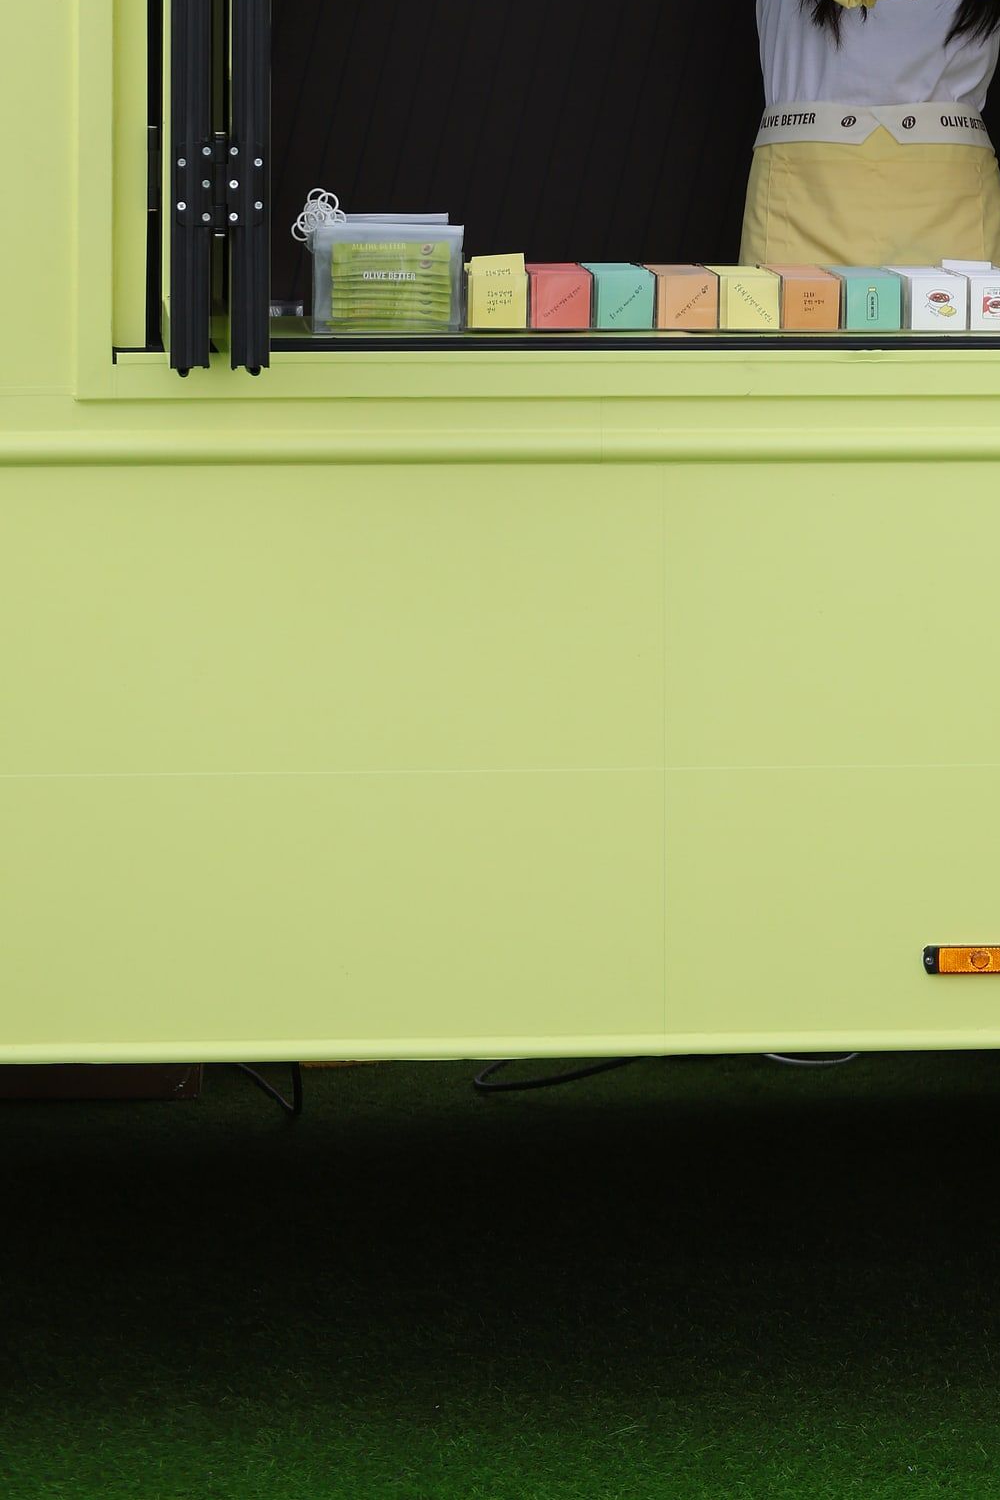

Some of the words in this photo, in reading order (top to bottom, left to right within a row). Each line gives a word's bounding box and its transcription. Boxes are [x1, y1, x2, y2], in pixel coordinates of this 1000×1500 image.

[781, 112, 816, 126] BETTER
[940, 115, 969, 128] OLIVE
[363, 271, 387, 280] OLIVE
[388, 272, 416, 281] BETTER
